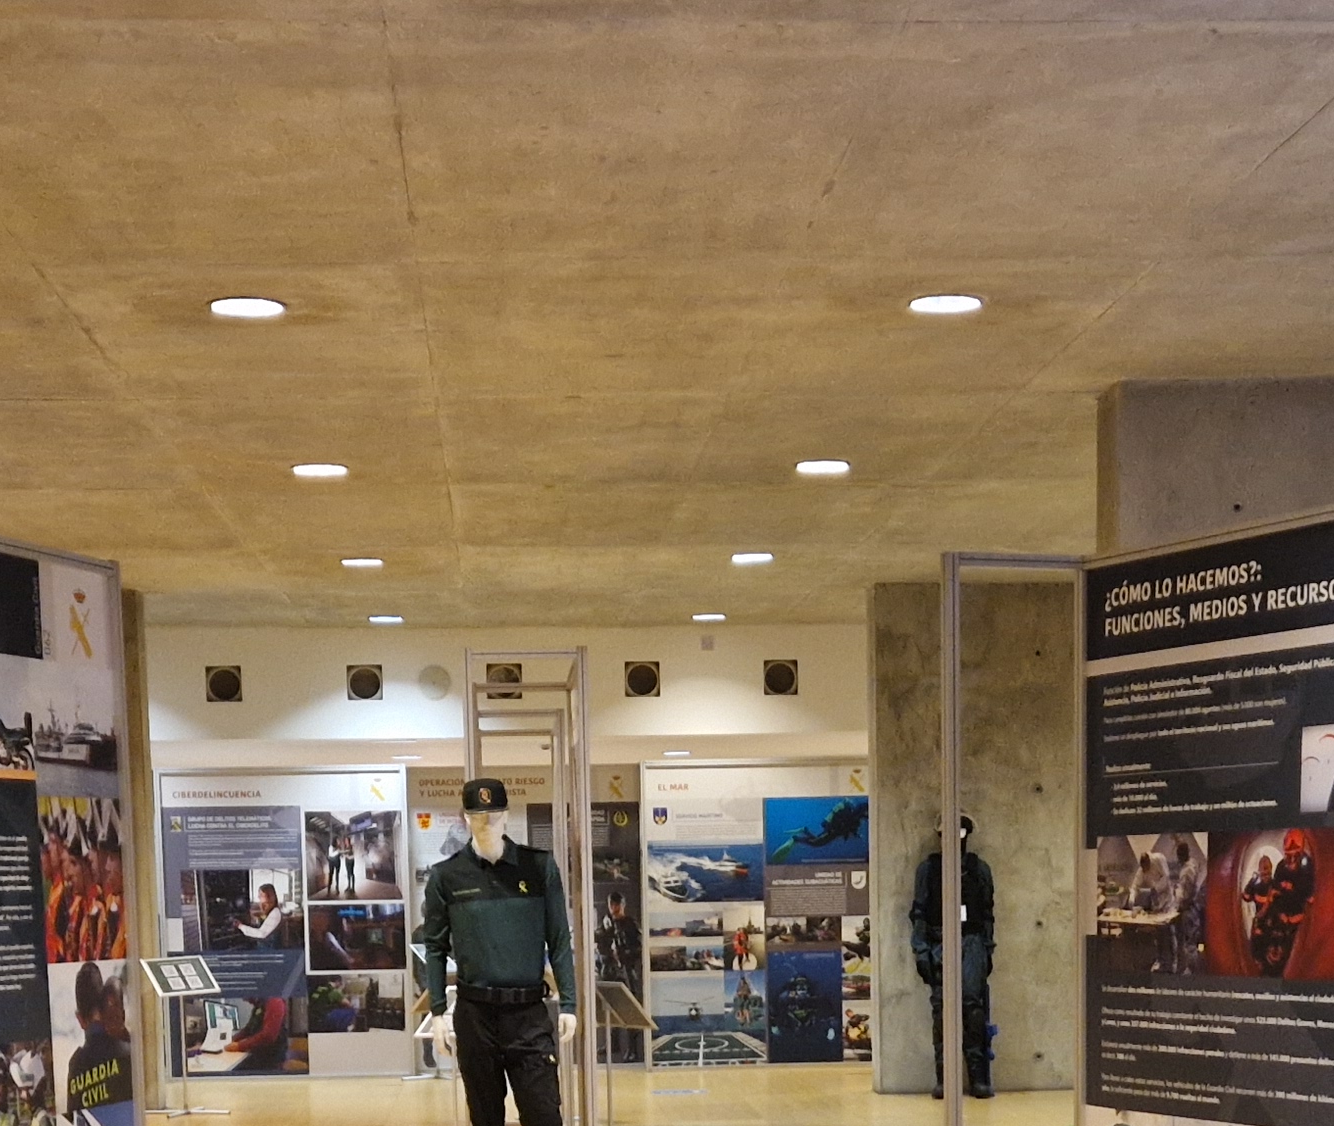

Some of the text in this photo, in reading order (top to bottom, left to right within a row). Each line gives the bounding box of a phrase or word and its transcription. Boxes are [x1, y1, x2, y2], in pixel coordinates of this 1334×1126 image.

[1104, 560, 1262, 612] ¿CÓMO LO HACEMOS?:
[1104, 605, 1185, 637] FUNCIONES,
[1189, 594, 1248, 622] MEDIOS
[1252, 591, 1263, 612] Y
[515, 777, 545, 786] RIESGO
[658, 783, 689, 791] EL MAR
[172, 790, 261, 799] CIBERDELINCUENCIA
[427, 789, 455, 797] LUCHA
[70, 1058, 119, 1095] GUARDIA
[81, 1083, 109, 1107] CIVIL
